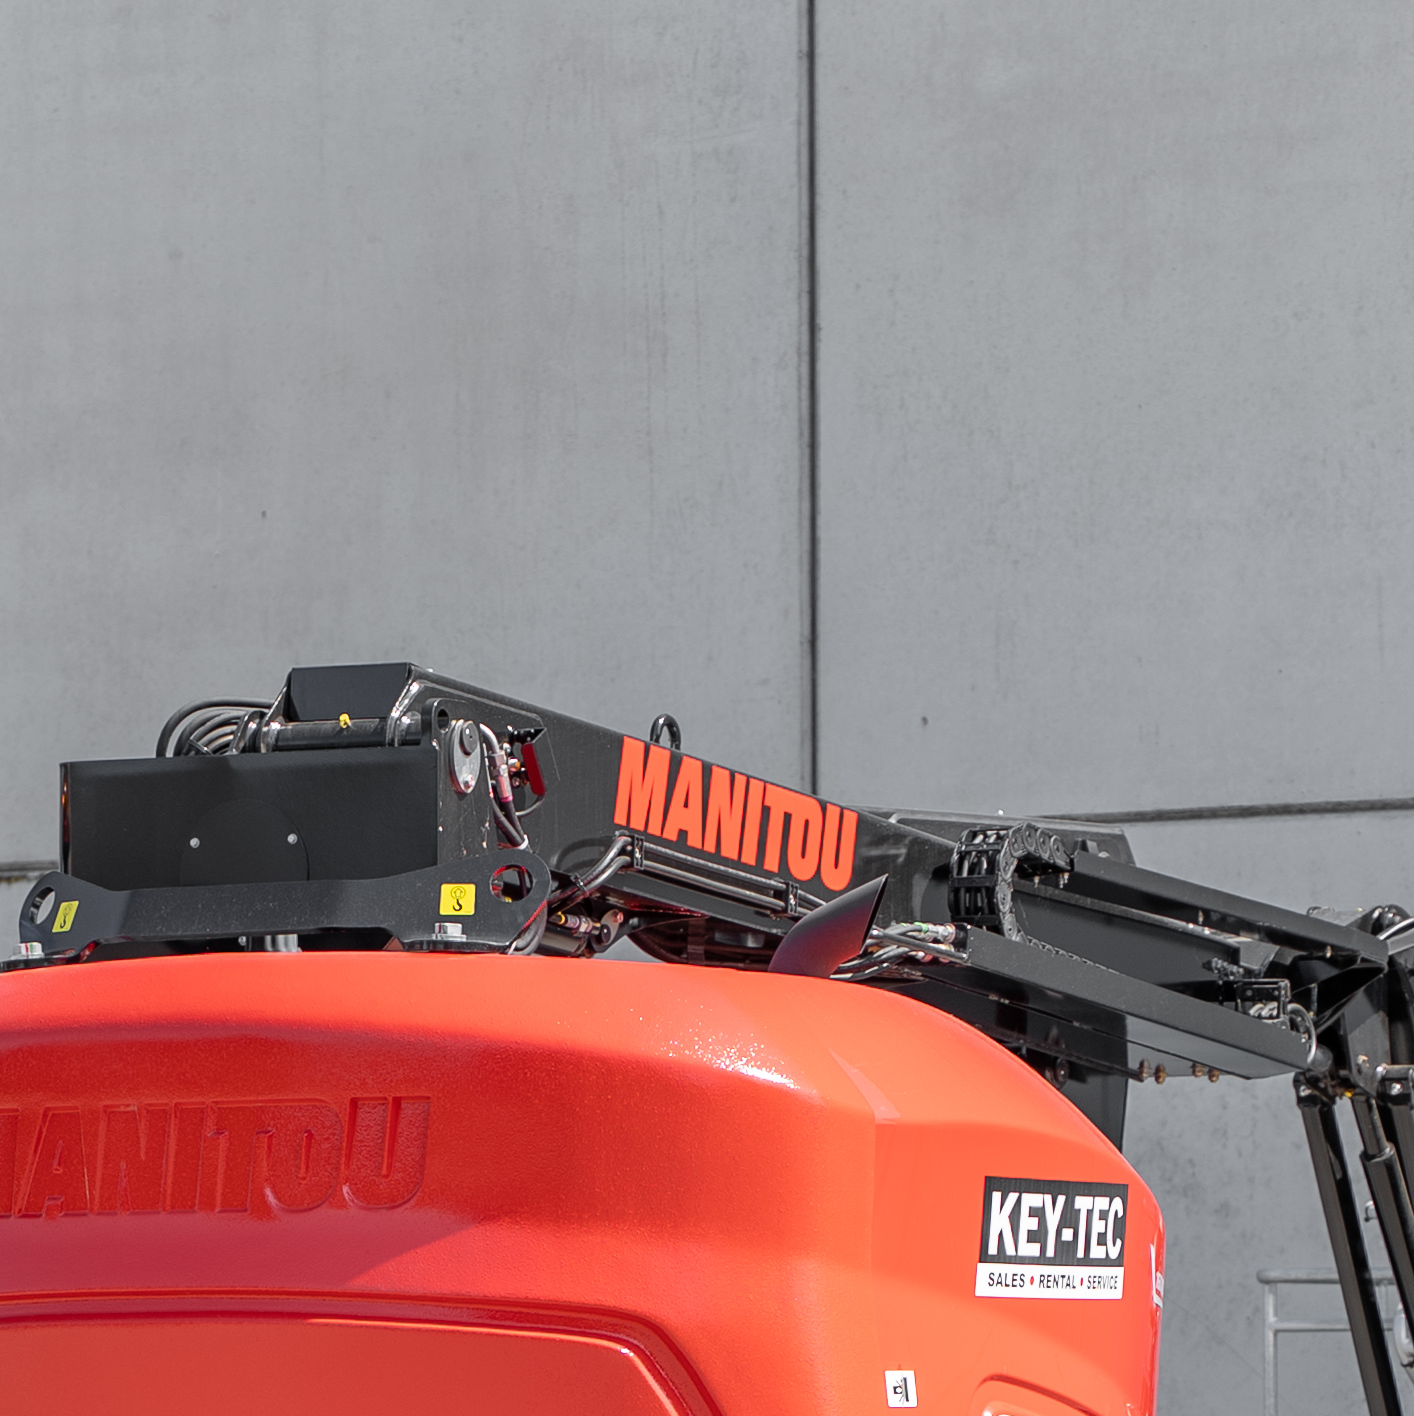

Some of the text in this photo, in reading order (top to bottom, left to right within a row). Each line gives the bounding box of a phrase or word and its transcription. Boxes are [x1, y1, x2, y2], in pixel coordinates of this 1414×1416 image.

[613, 735, 859, 892] MANITOU
[987, 1190, 1125, 1260] KEY-TEC
[987, 1272, 1119, 1290] SALES RENTAL SERVICE
